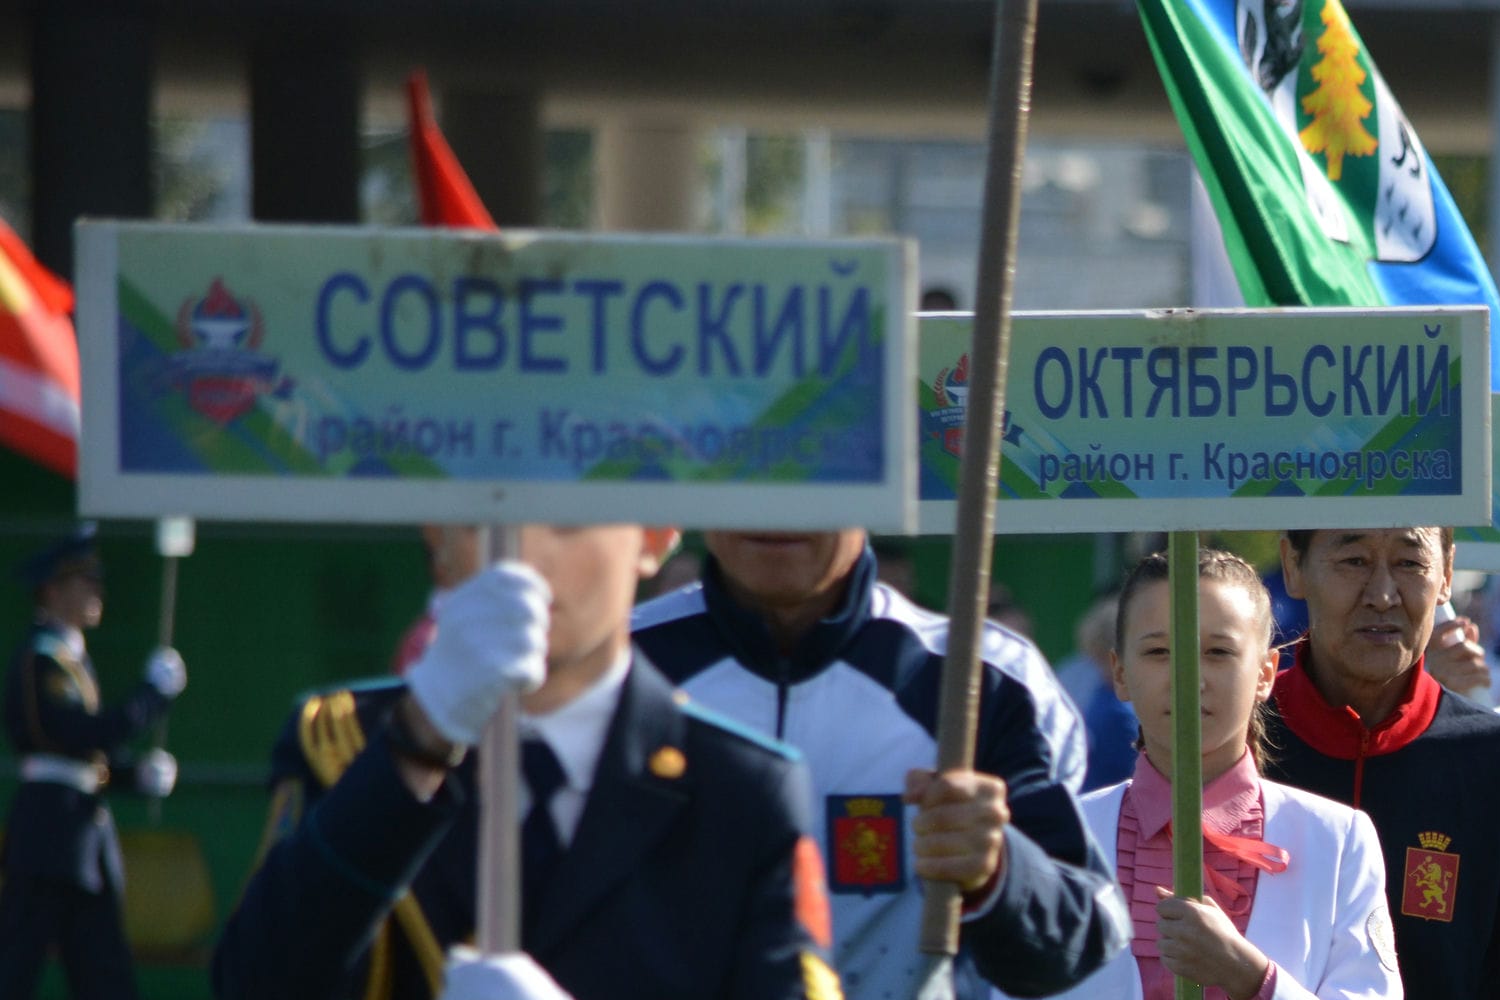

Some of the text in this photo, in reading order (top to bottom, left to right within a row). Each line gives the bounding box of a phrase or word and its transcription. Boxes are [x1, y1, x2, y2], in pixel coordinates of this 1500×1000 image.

[315, 259, 869, 379] СОВЕТСКИЙ
[1034, 324, 1449, 420] ОКТЯБРЬСКИЙ
[318, 406, 475, 463] район
[491, 422, 522, 457] г.
[1040, 442, 1452, 493] район г. Красноярска
